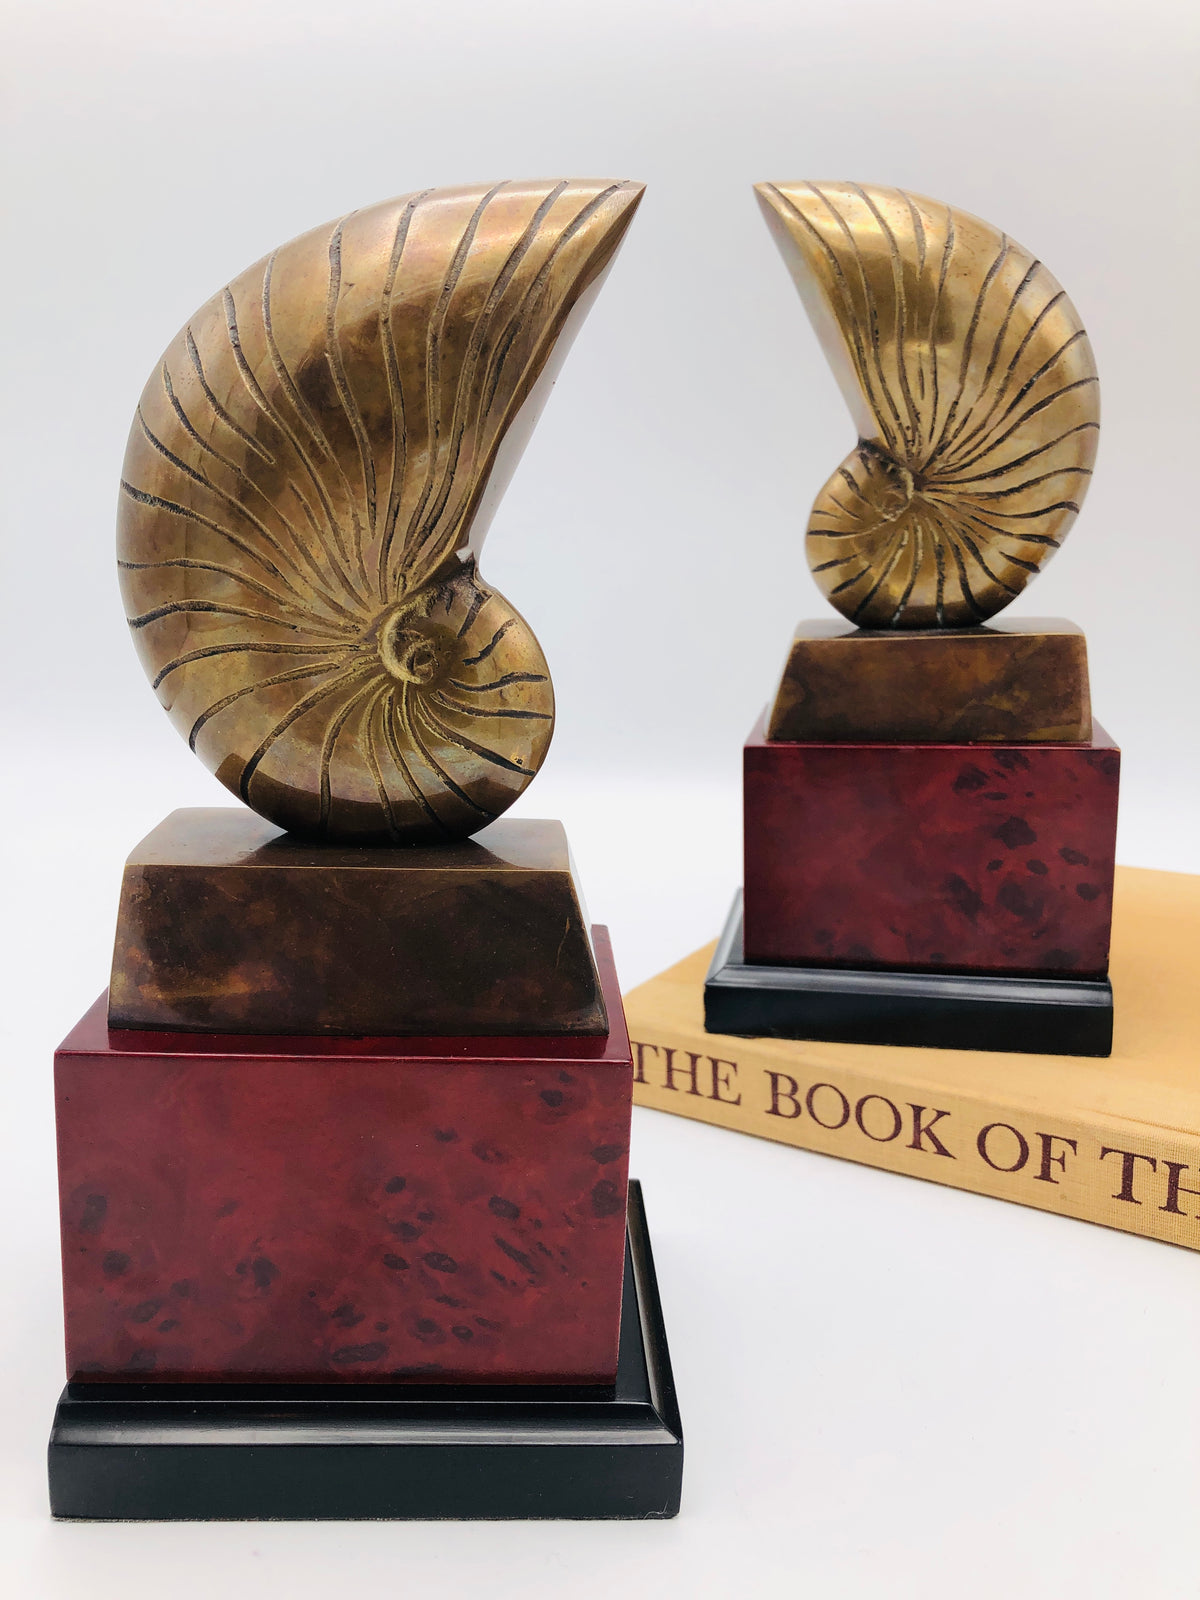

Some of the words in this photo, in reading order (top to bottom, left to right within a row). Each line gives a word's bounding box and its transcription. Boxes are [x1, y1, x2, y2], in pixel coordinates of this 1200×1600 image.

[631, 1041, 742, 1105] THE
[764, 1070, 957, 1160] BOOK
[977, 1123, 1078, 1184] OF
